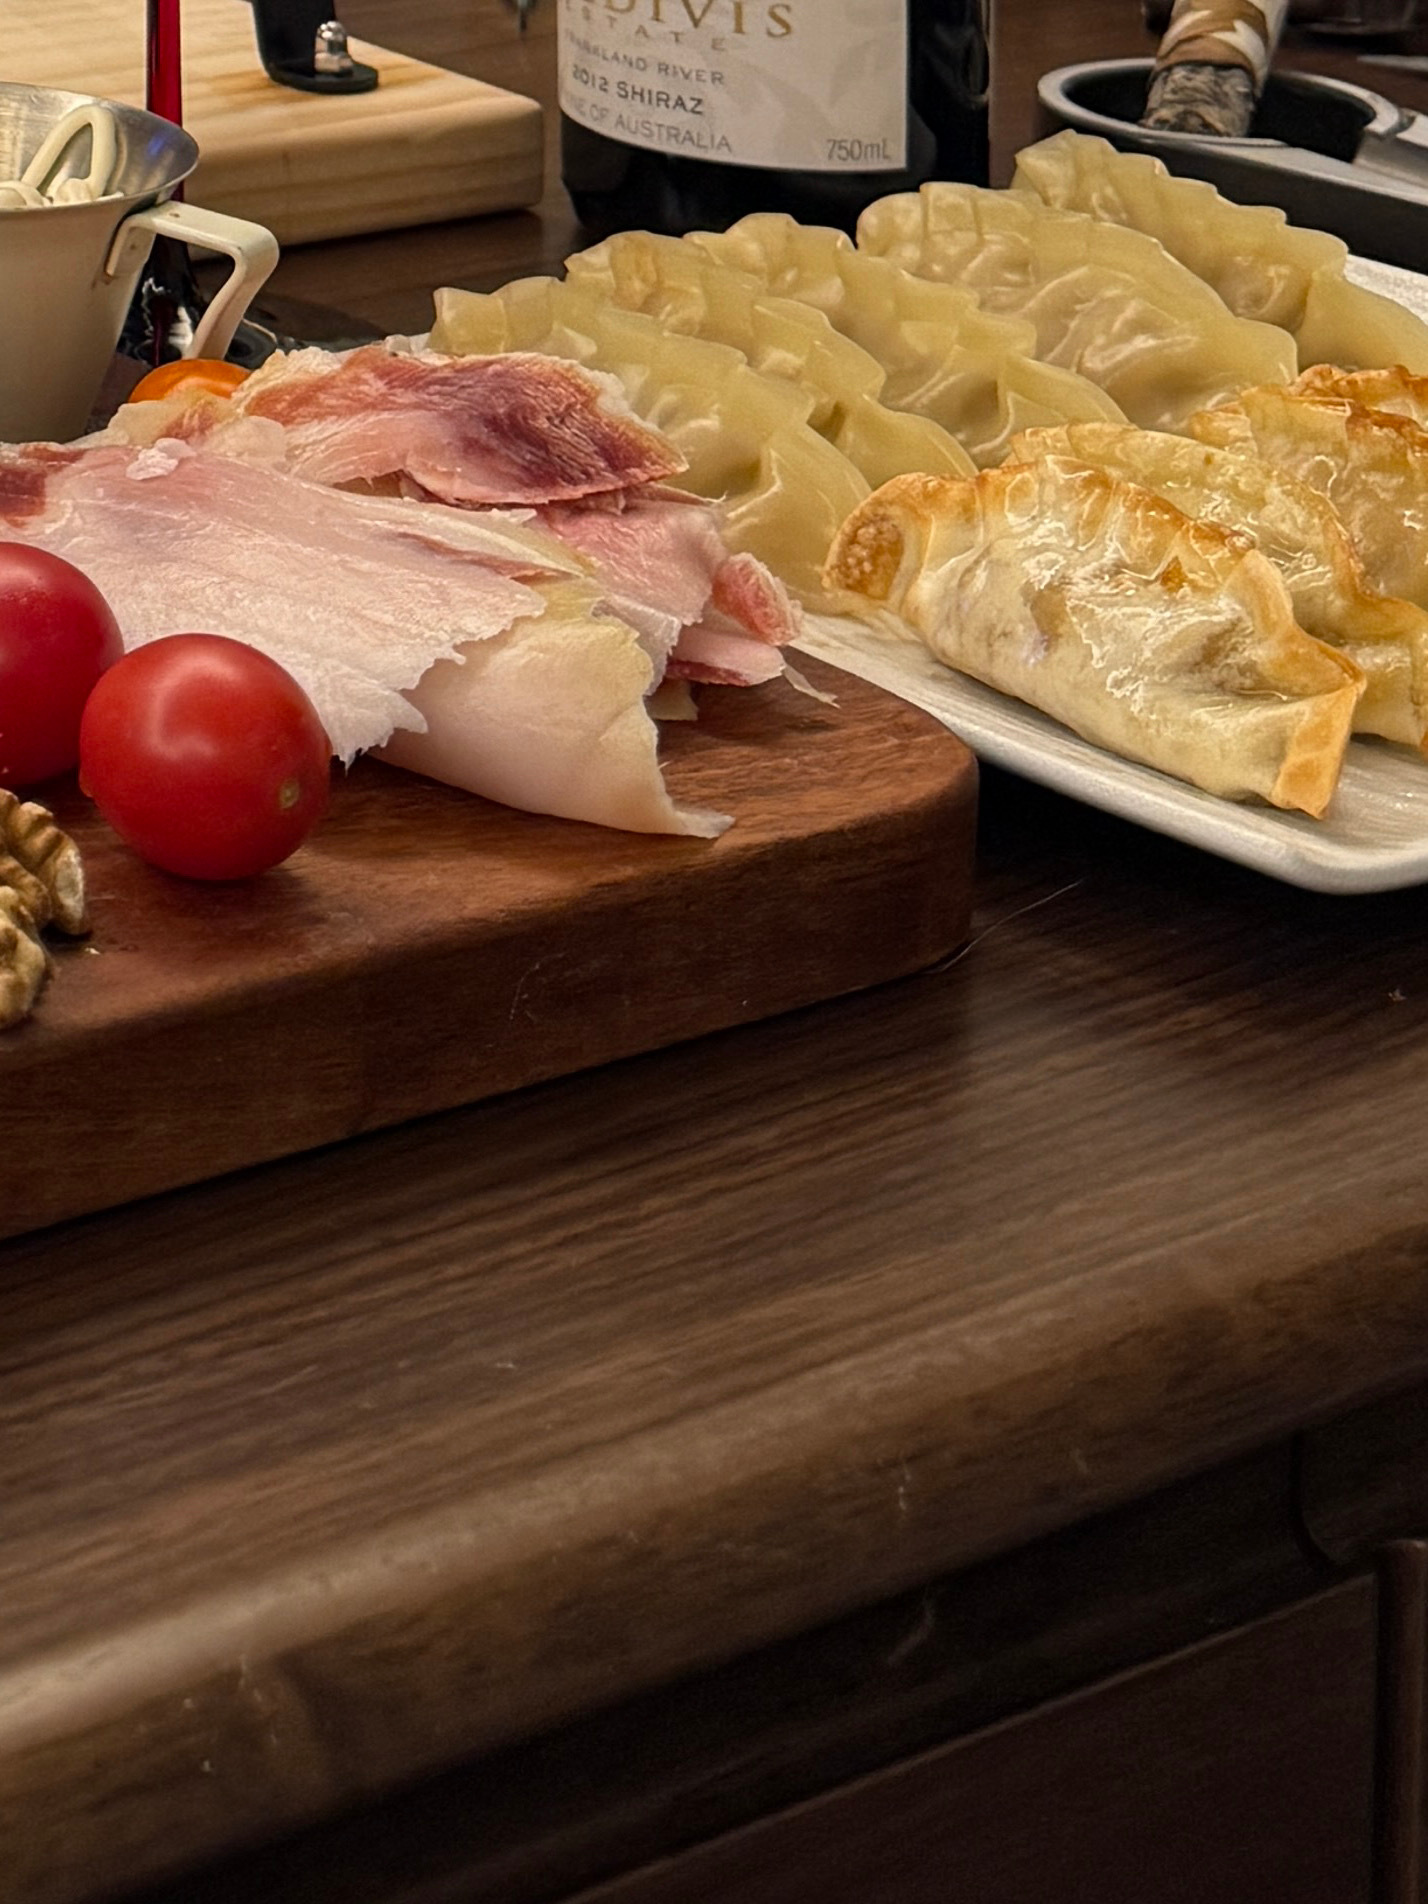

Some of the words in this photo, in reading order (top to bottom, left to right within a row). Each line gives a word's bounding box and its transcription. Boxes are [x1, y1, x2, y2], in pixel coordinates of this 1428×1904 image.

[572, 64, 610, 92] 2012
[615, 80, 705, 116] SHIRAZ
[657, 61, 726, 86] RIVER
[588, 103, 610, 124] OF
[614, 113, 734, 154] AUSTRALIA
[826, 138, 893, 162] 750mL
